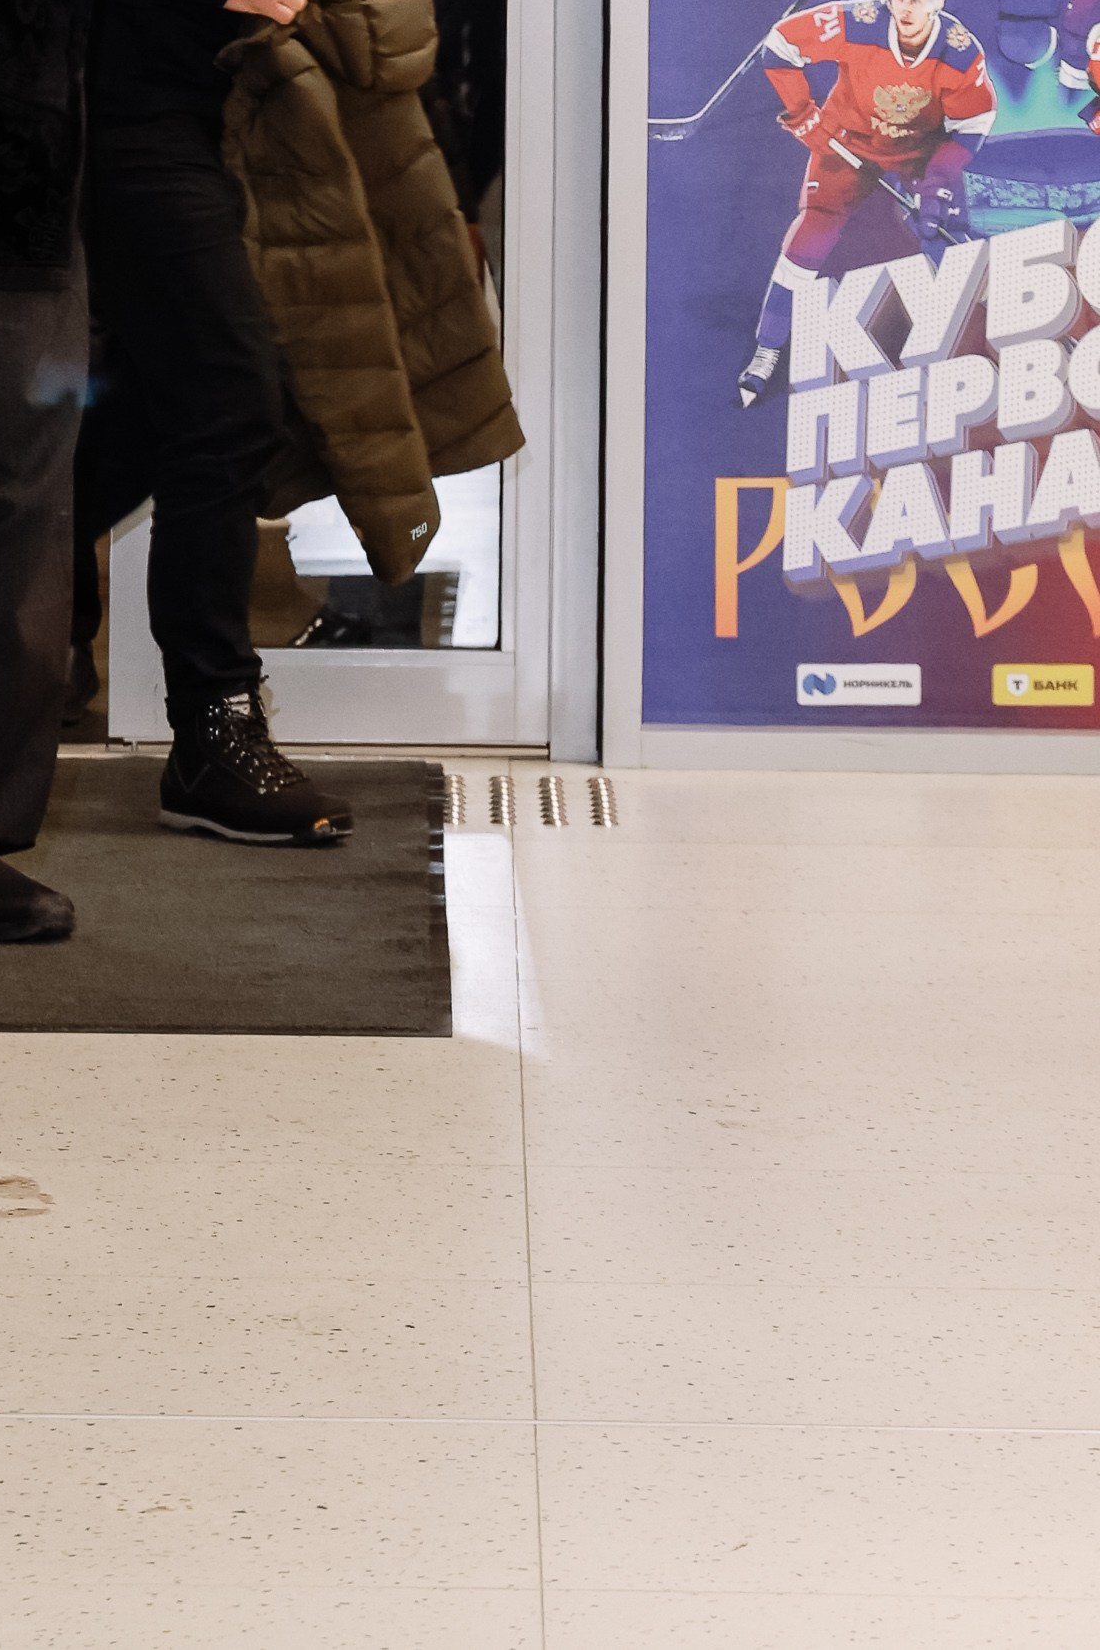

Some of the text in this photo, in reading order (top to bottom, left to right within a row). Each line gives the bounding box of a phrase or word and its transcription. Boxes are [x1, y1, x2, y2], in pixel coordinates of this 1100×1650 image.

[790, 218, 1100, 385] КУБ
[783, 429, 1100, 572] КАНА
[1033, 680, 1079, 692] БАНК
